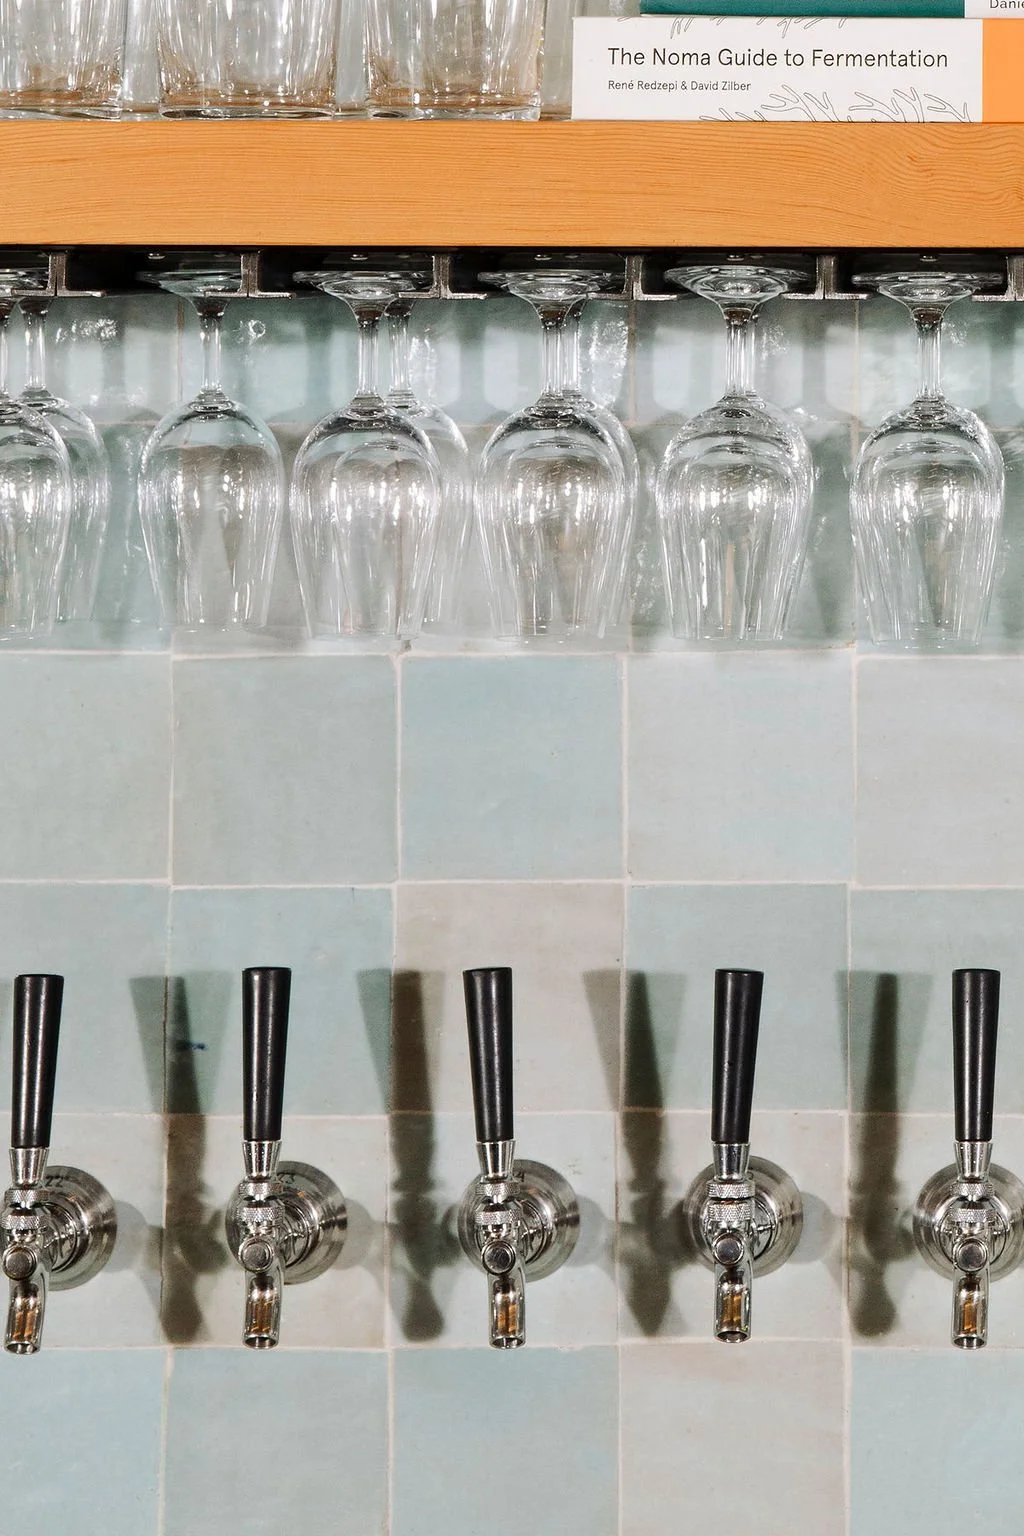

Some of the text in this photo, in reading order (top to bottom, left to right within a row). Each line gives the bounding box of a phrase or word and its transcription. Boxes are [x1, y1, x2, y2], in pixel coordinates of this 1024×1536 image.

[608, 47, 949, 68] The Noma Guide to Fermentation
[608, 80, 751, 93] René Redzepi & David Zilber
